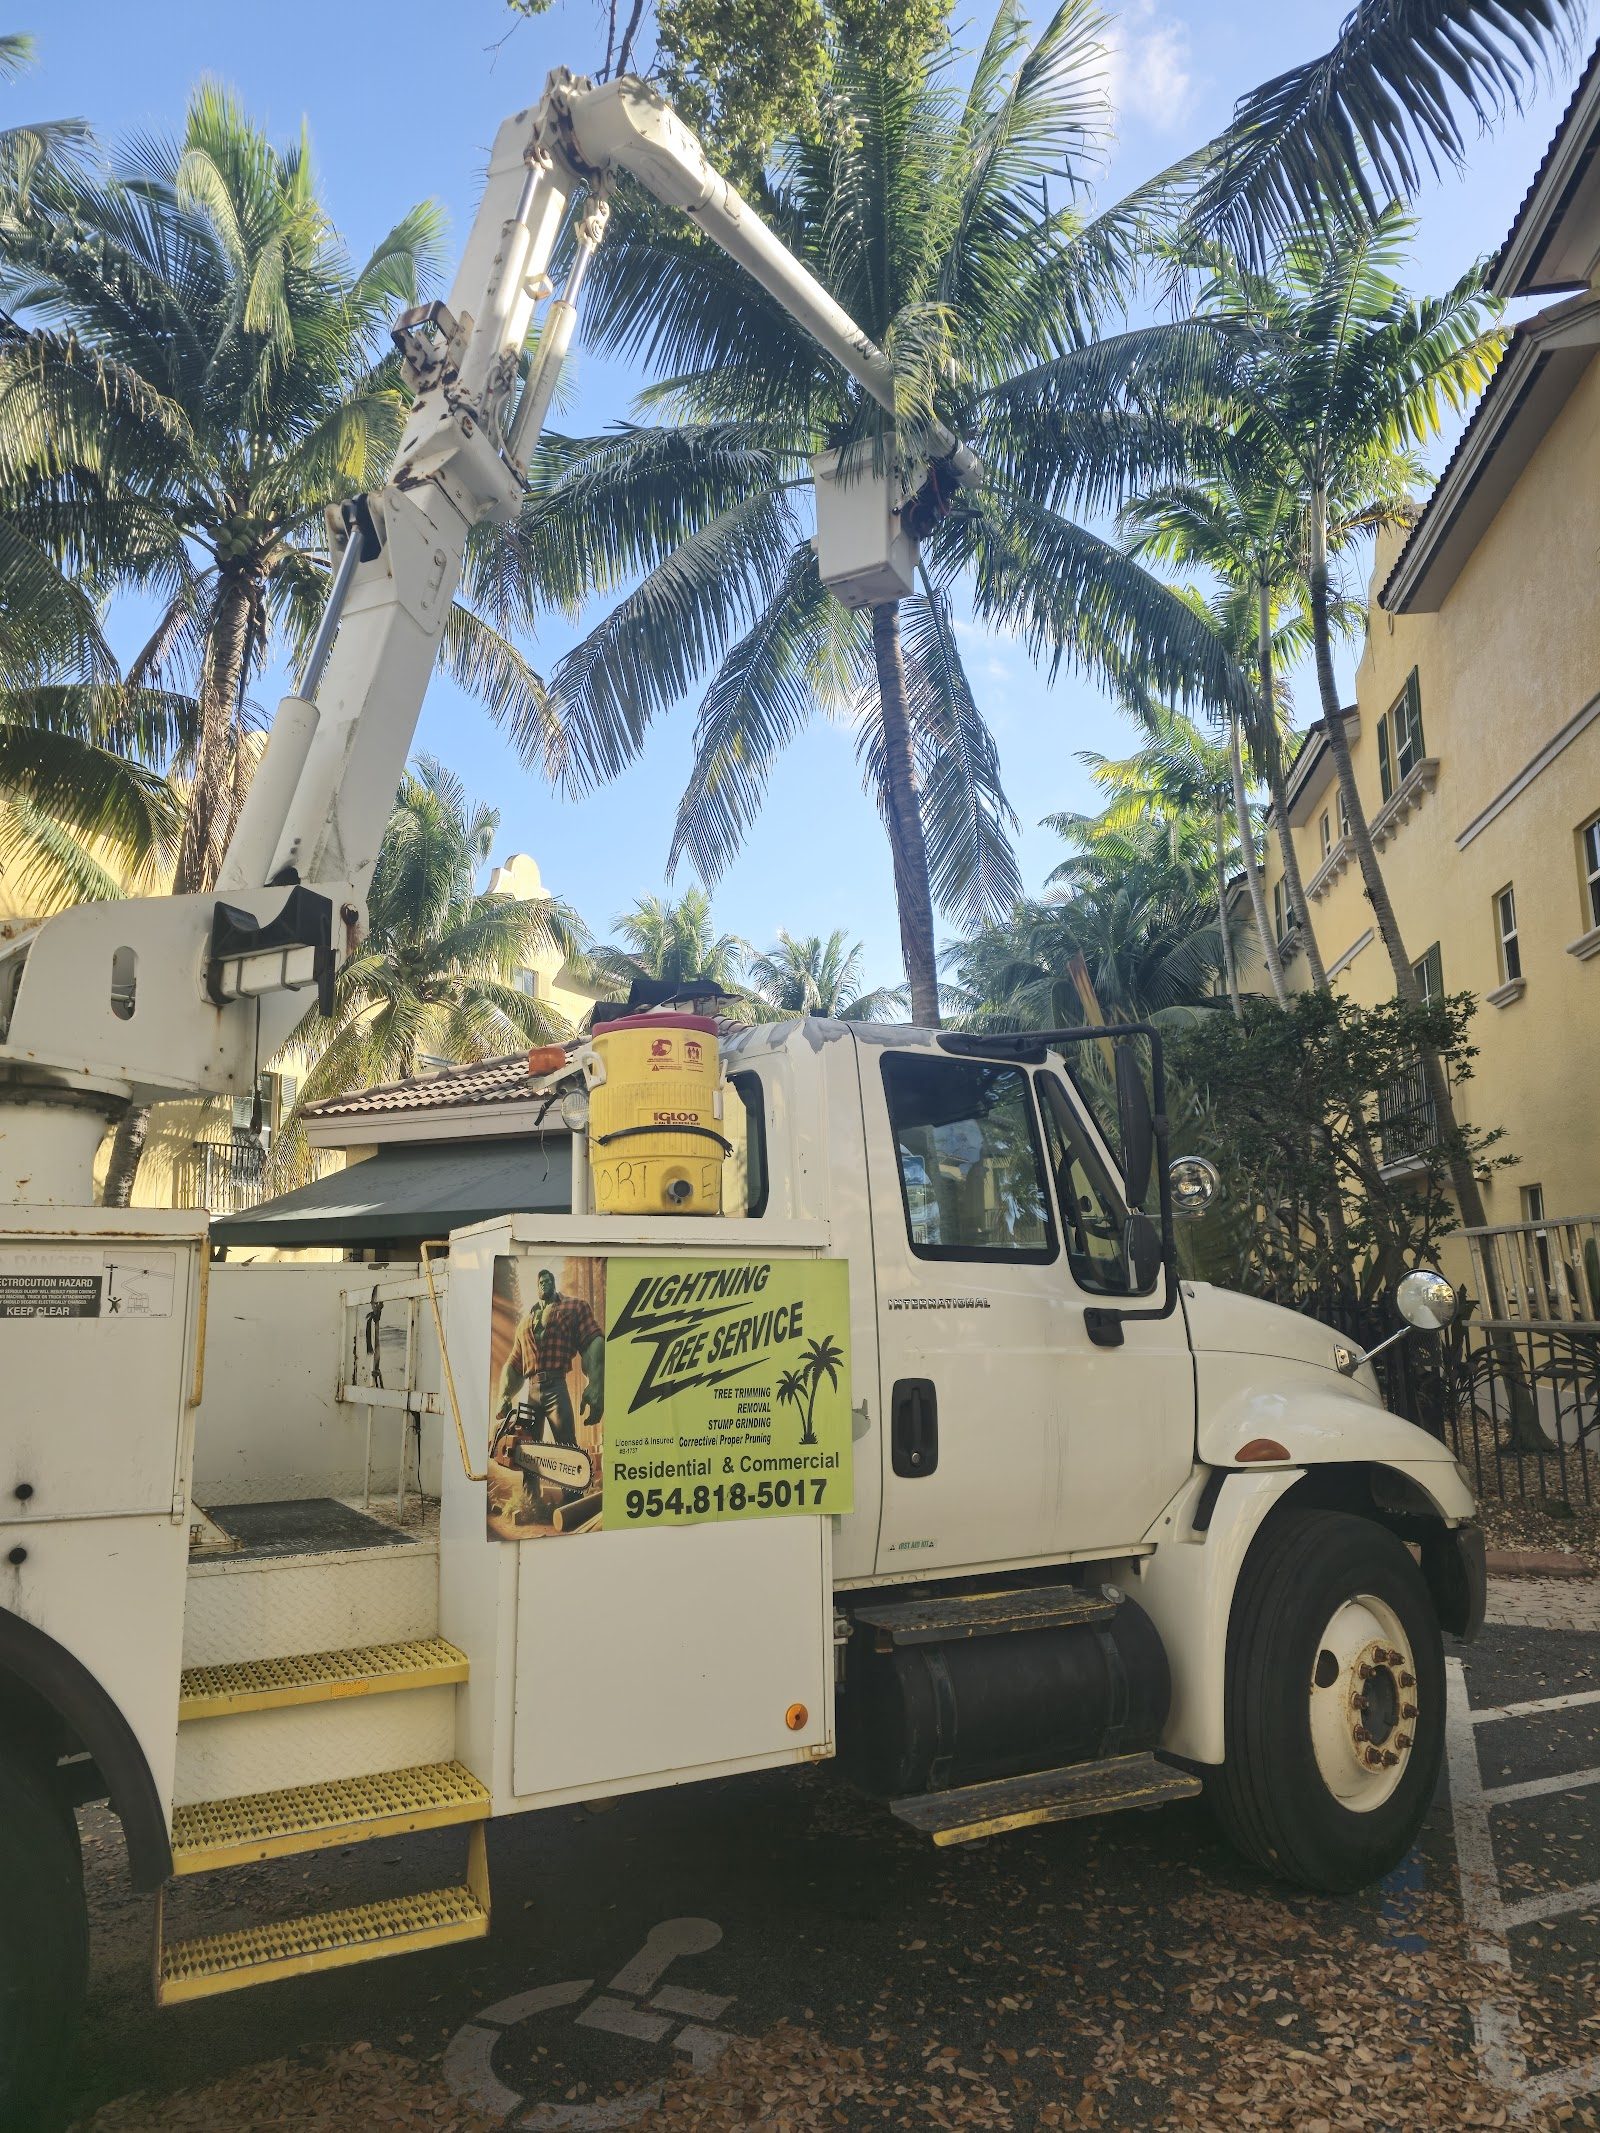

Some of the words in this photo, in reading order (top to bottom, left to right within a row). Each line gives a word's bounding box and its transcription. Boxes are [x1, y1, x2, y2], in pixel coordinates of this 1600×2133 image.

[653, 1112, 699, 1124] IGLOO
[59, 1278, 93, 1287] HAZARD
[607, 1264, 771, 1342] LIGHTNING
[888, 1298, 991, 1310] INTERNATIONAL
[6, 1306, 34, 1316] KEEP
[36, 1306, 70, 1316] CLEAR
[707, 1301, 803, 1364] SERVICE
[713, 1388, 733, 1399] TREE
[734, 1387, 771, 1399] TRIMMING
[737, 1402, 771, 1414] REMOVAL
[708, 1419, 734, 1430] STUMP
[735, 1417, 771, 1429] GRINDING
[615, 1438, 643, 1447] Licensed
[644, 1437, 649, 1445] &
[650, 1436, 674, 1445] Insured
[719, 1434, 743, 1446] Proper
[744, 1433, 771, 1446] Pruning
[559, 1462, 577, 1476] TREE
[614, 1458, 712, 1481] Residential
[722, 1456, 735, 1474] &
[740, 1452, 839, 1473] Commercial
[626, 1478, 827, 1519] 954.818-5017
